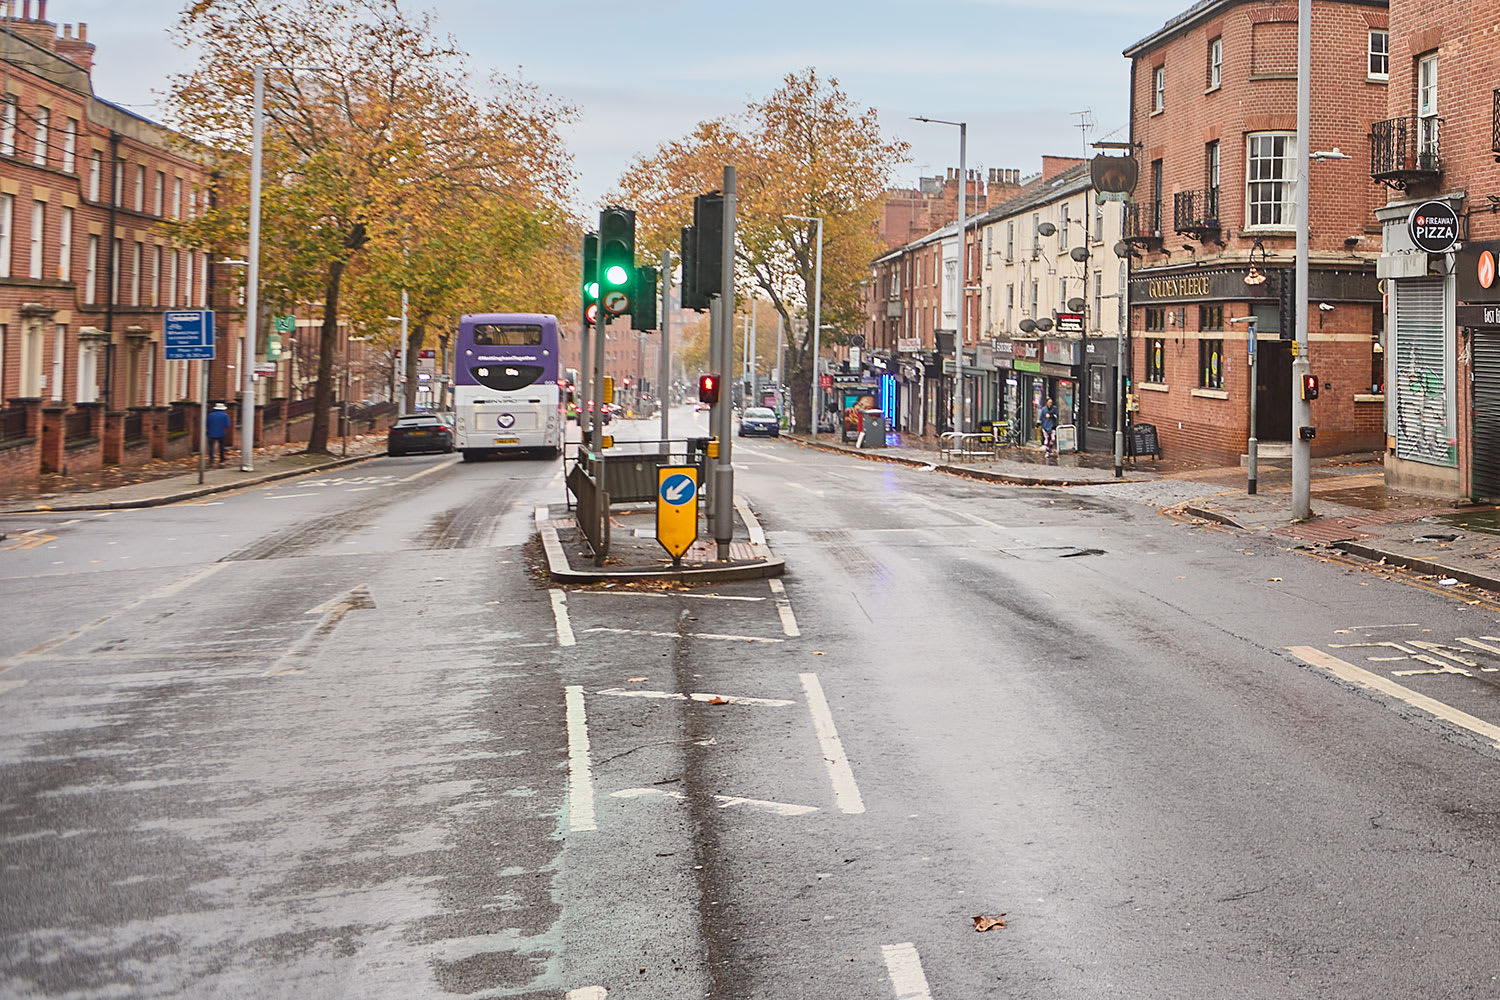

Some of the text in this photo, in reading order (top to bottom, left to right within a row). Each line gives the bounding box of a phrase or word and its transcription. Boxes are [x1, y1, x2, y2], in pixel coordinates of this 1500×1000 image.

[1425, 216, 1454, 225] FIREAWAY
[1416, 226, 1454, 239] PIZZA
[1148, 276, 1210, 298] GOLDEN FLEECE
